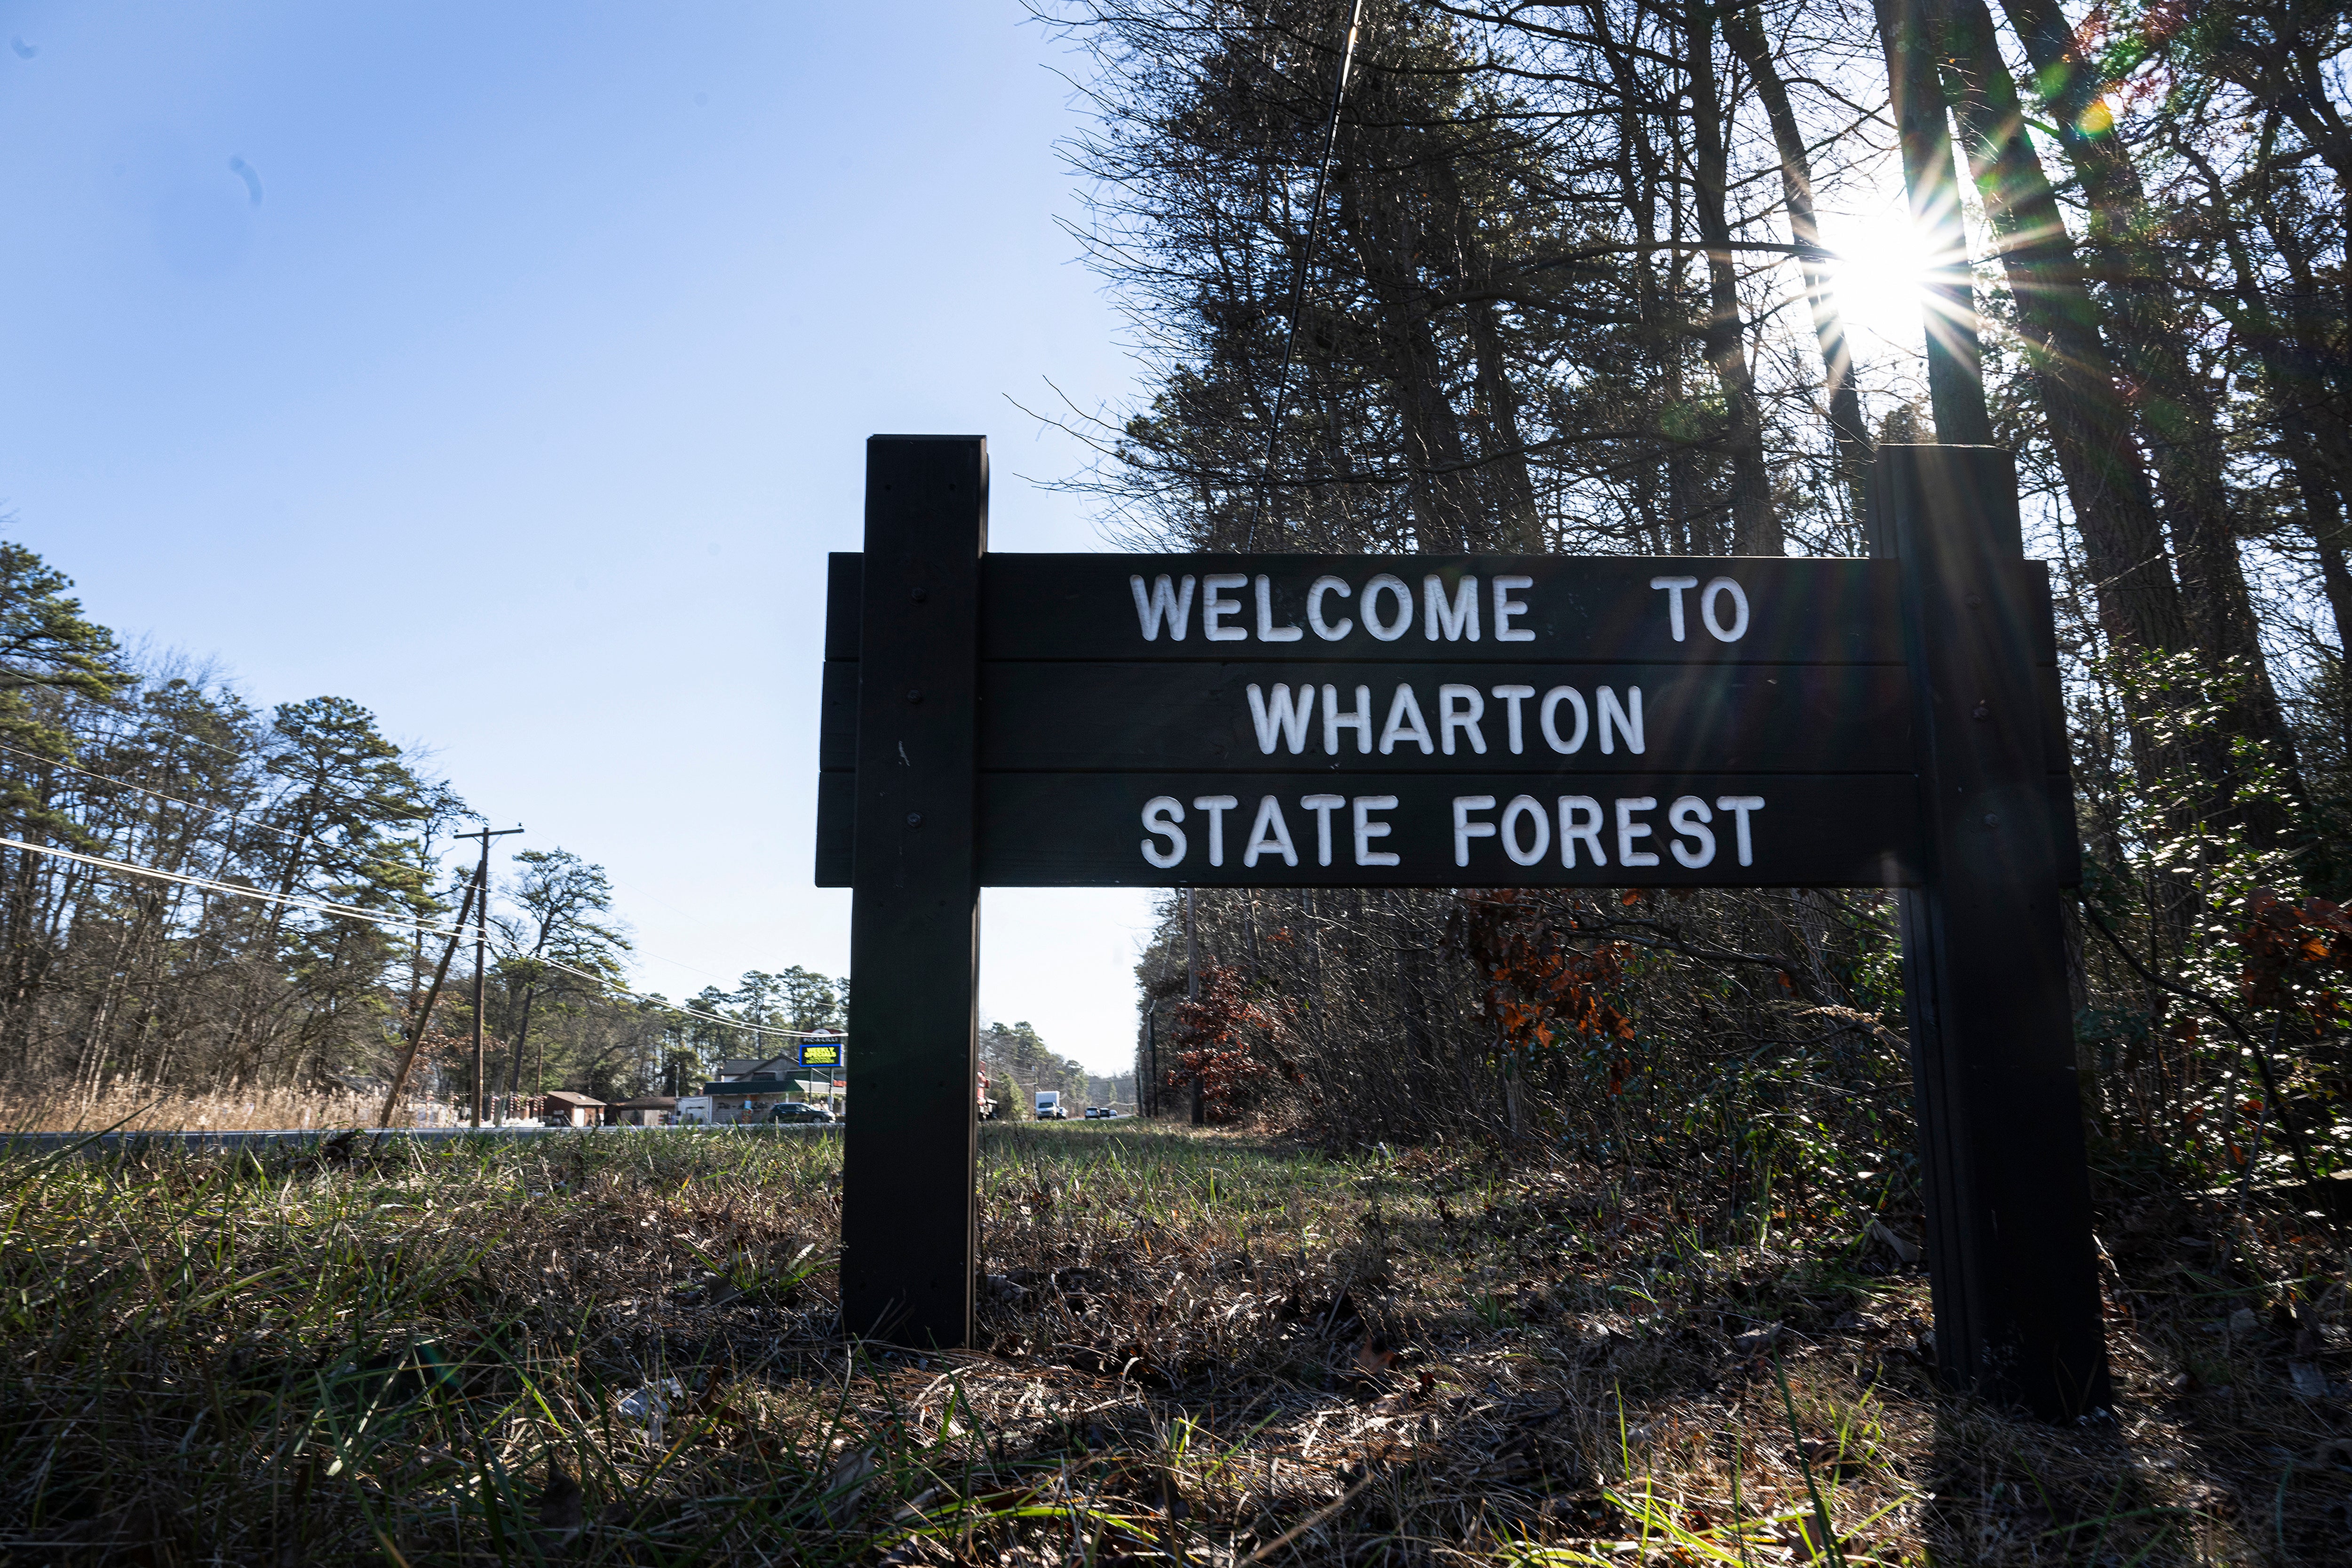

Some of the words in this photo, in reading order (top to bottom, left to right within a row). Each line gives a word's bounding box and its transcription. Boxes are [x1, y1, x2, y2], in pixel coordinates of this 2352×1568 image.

[1130, 573, 1536, 643] WELCOME
[1650, 575, 1750, 643] TO
[1246, 683, 1645, 755] WHARTON
[1141, 795, 1400, 869] STATE
[1453, 795, 1765, 869] FOREST
